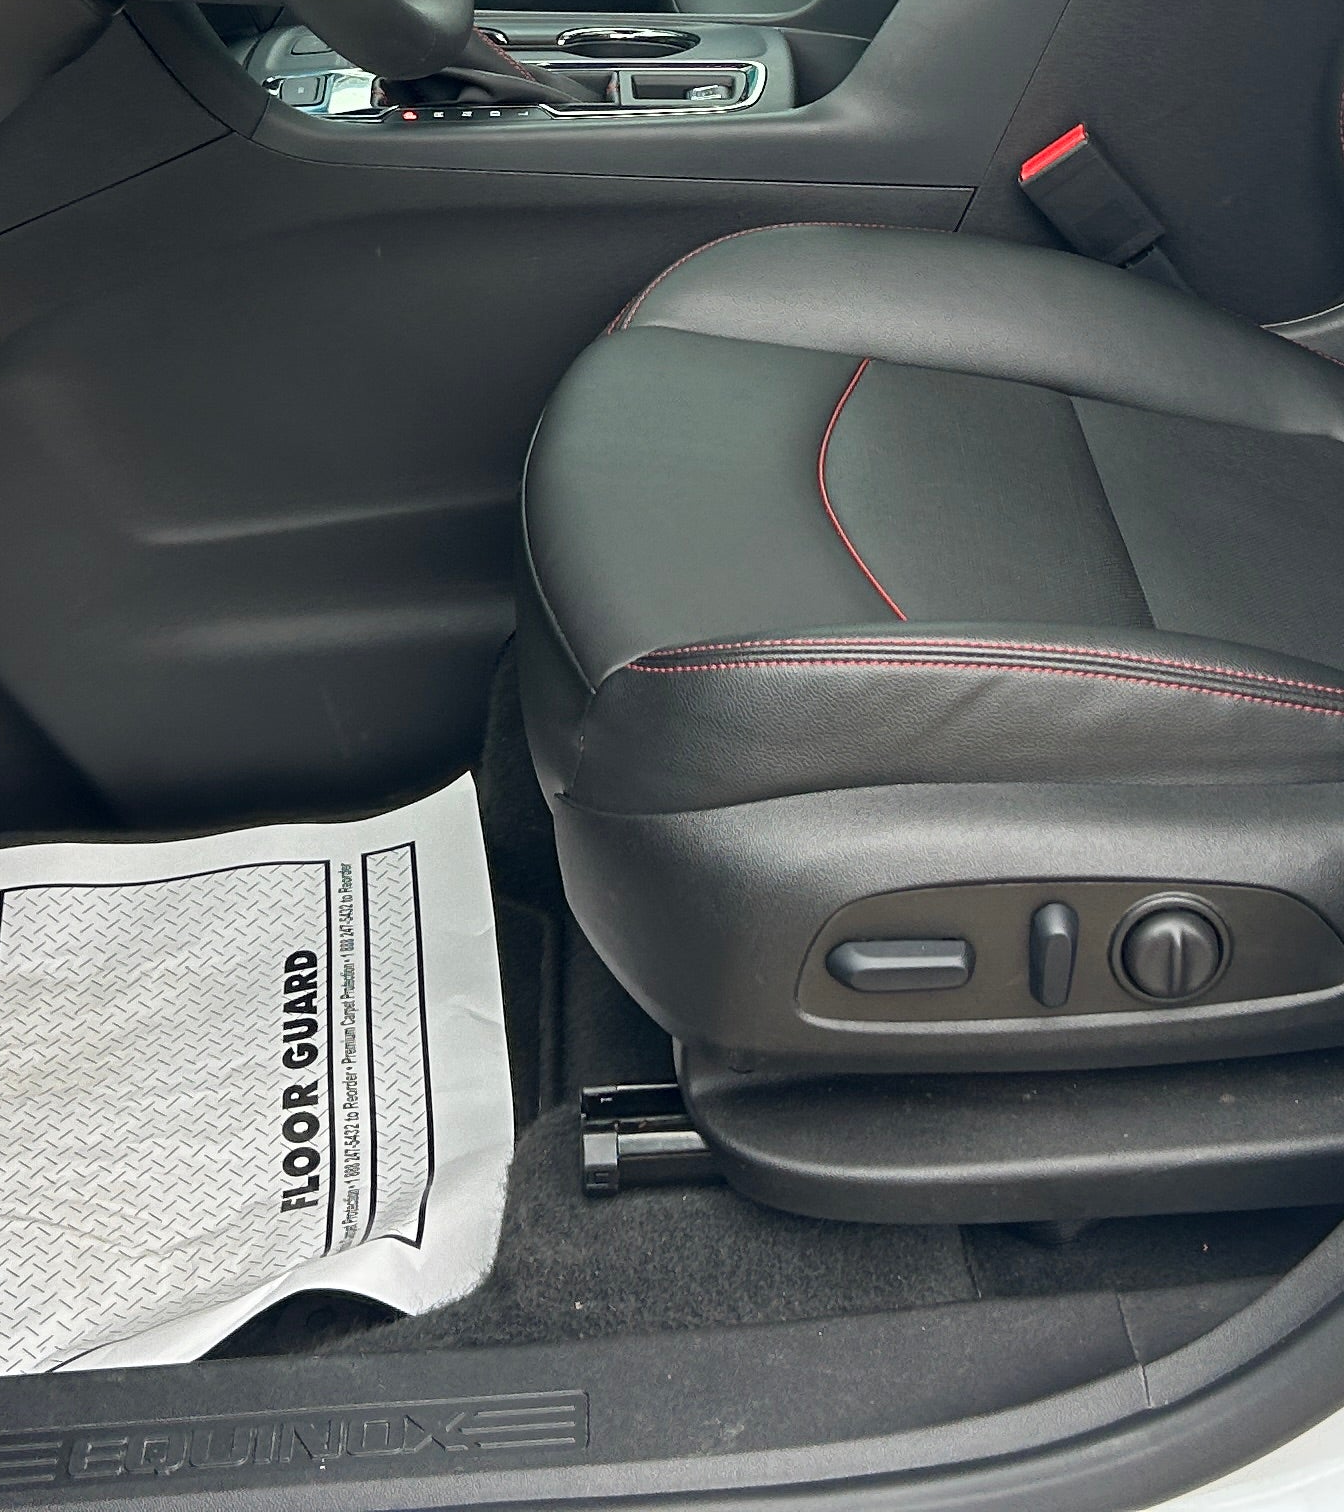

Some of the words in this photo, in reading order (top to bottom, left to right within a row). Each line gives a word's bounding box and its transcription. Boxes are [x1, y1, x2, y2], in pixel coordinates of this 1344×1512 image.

[339, 904, 355, 937] 247-5432
[283, 949, 318, 1069] GUARD
[342, 1072, 358, 1109] Reorder
[344, 1111, 360, 1122] to
[280, 1079, 319, 1214] FLOOR
[67, 1411, 468, 1478] EQUINOX
